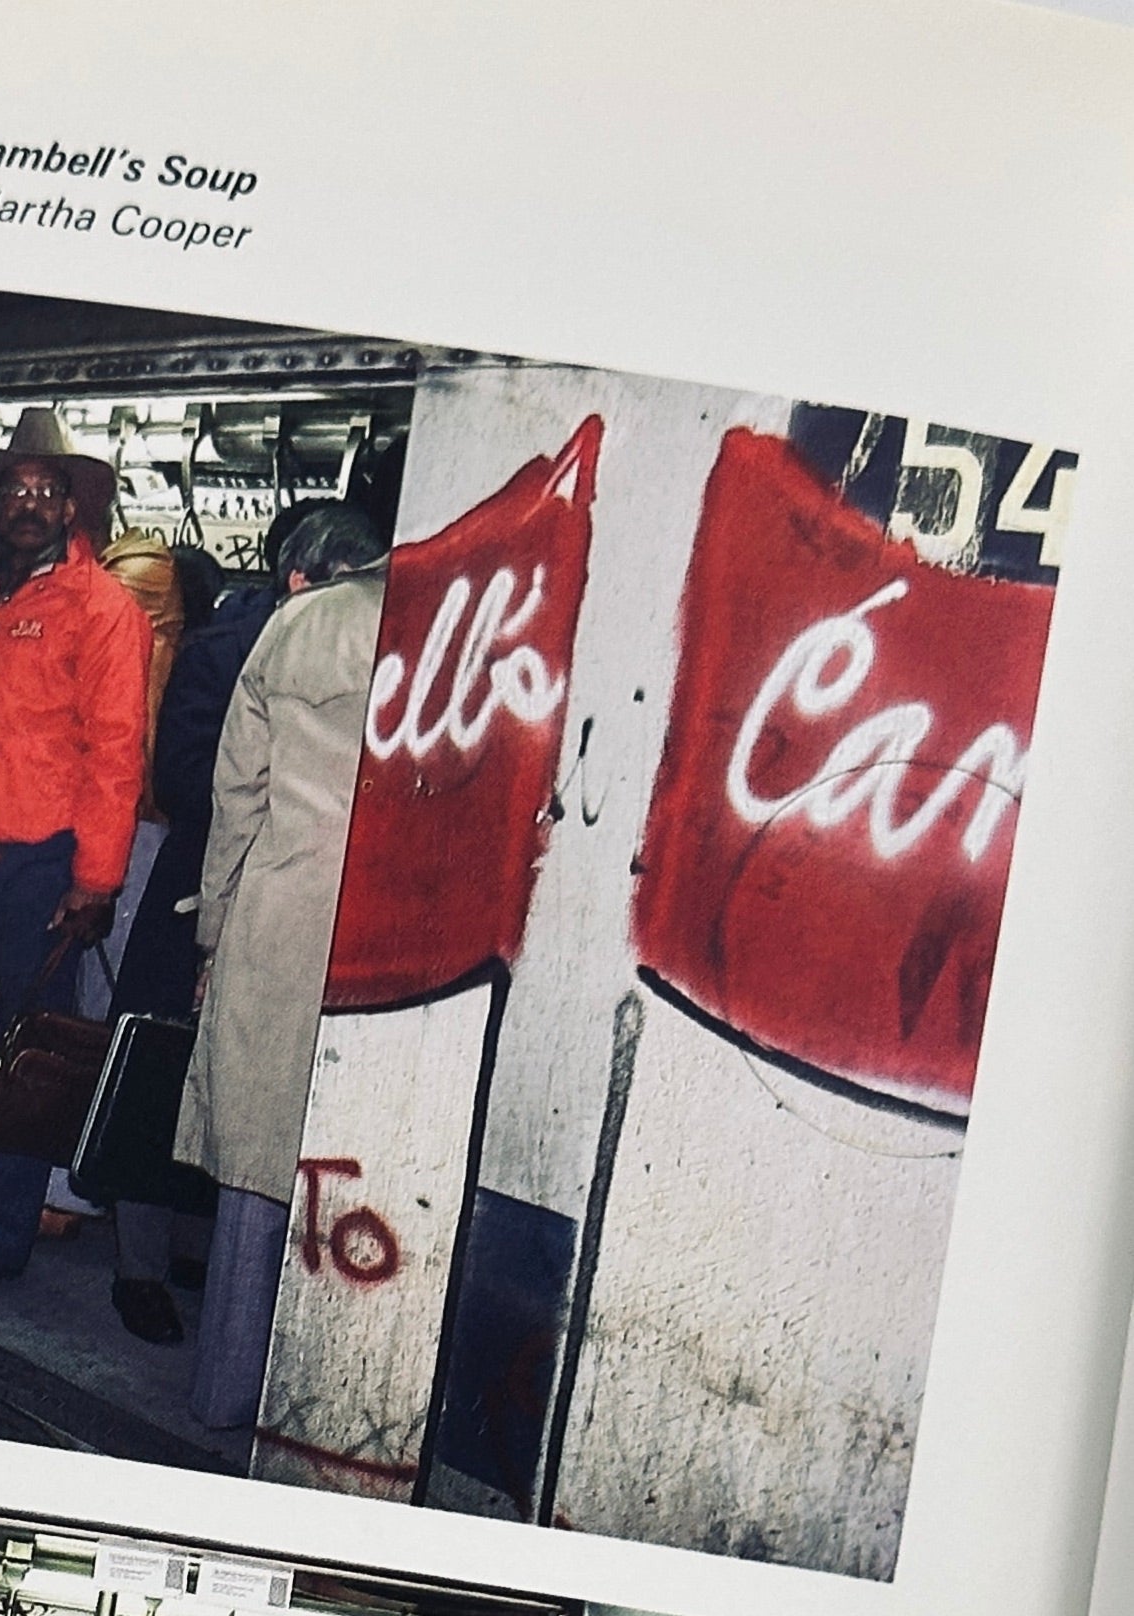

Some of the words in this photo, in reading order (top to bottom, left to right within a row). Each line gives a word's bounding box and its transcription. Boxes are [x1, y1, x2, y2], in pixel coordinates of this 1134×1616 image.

[157, 155, 257, 202] Soup
[110, 205, 253, 251] Cooper
[295, 1157, 401, 1284] To
